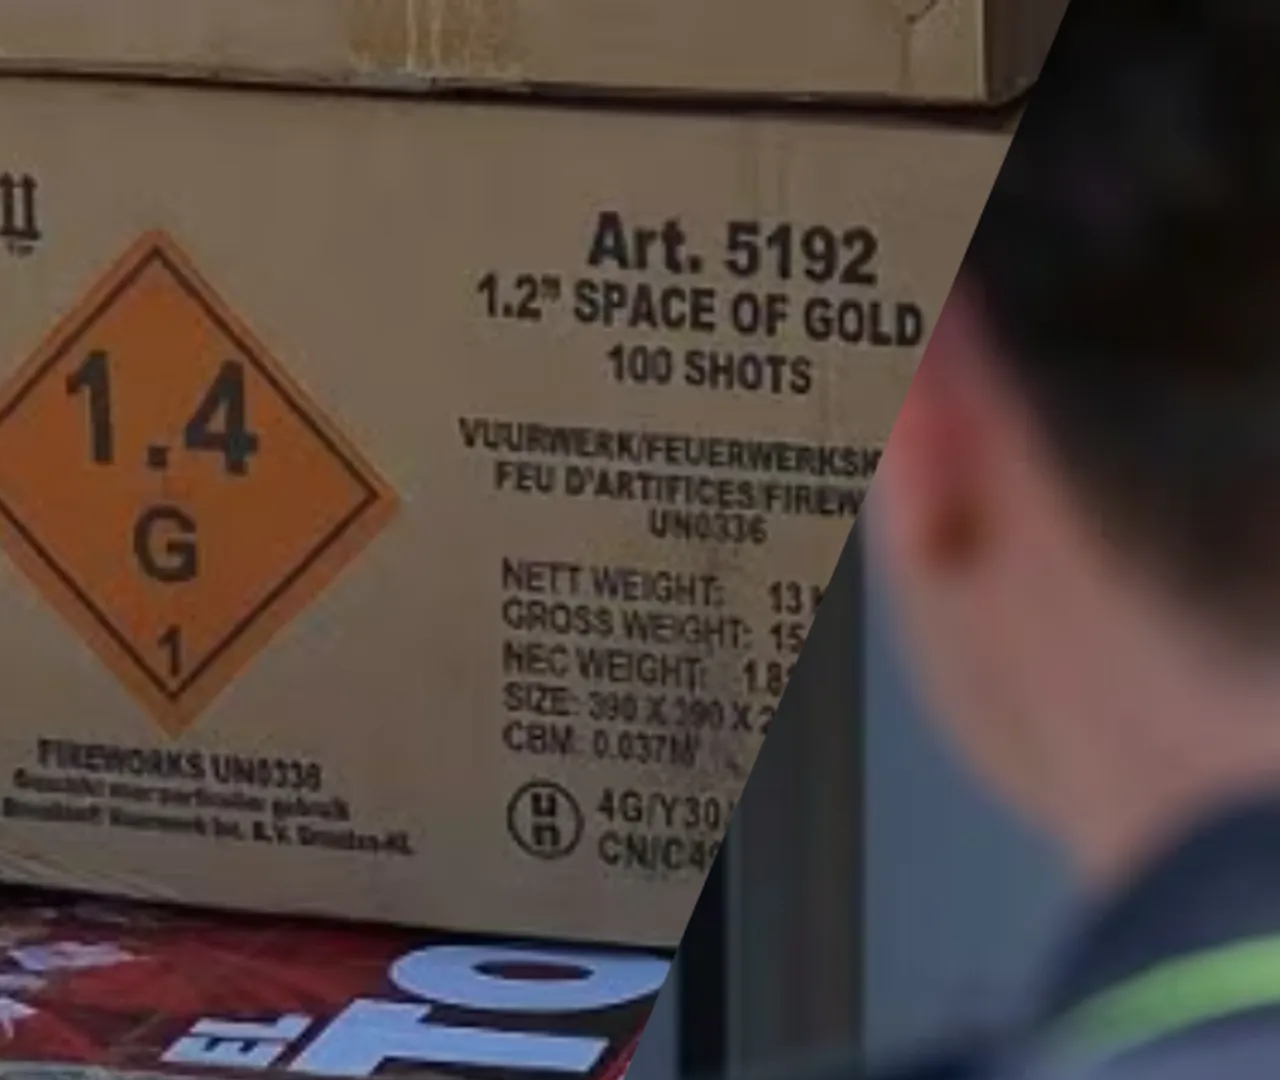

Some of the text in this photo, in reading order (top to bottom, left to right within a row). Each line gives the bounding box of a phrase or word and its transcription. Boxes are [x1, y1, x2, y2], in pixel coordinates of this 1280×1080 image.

[587, 211, 879, 286] Art. 5192
[573, 279, 716, 335] SPACE
[731, 292, 787, 338] OF
[803, 297, 924, 350] GOLD
[606, 344, 813, 396] 100 SHOTS
[65, 350, 260, 477] 1.4
[494, 460, 554, 495] FEU
[133, 506, 199, 584] G
[502, 558, 582, 598] NETT
[592, 565, 724, 608] WEIGHT:
[768, 580, 803, 615] 13
[157, 624, 181, 678] 1
[502, 600, 614, 640] GROSS
[624, 612, 753, 655] WEIGHT:
[502, 641, 570, 680] NEC
[596, 786, 737, 833] 4G/Y30
